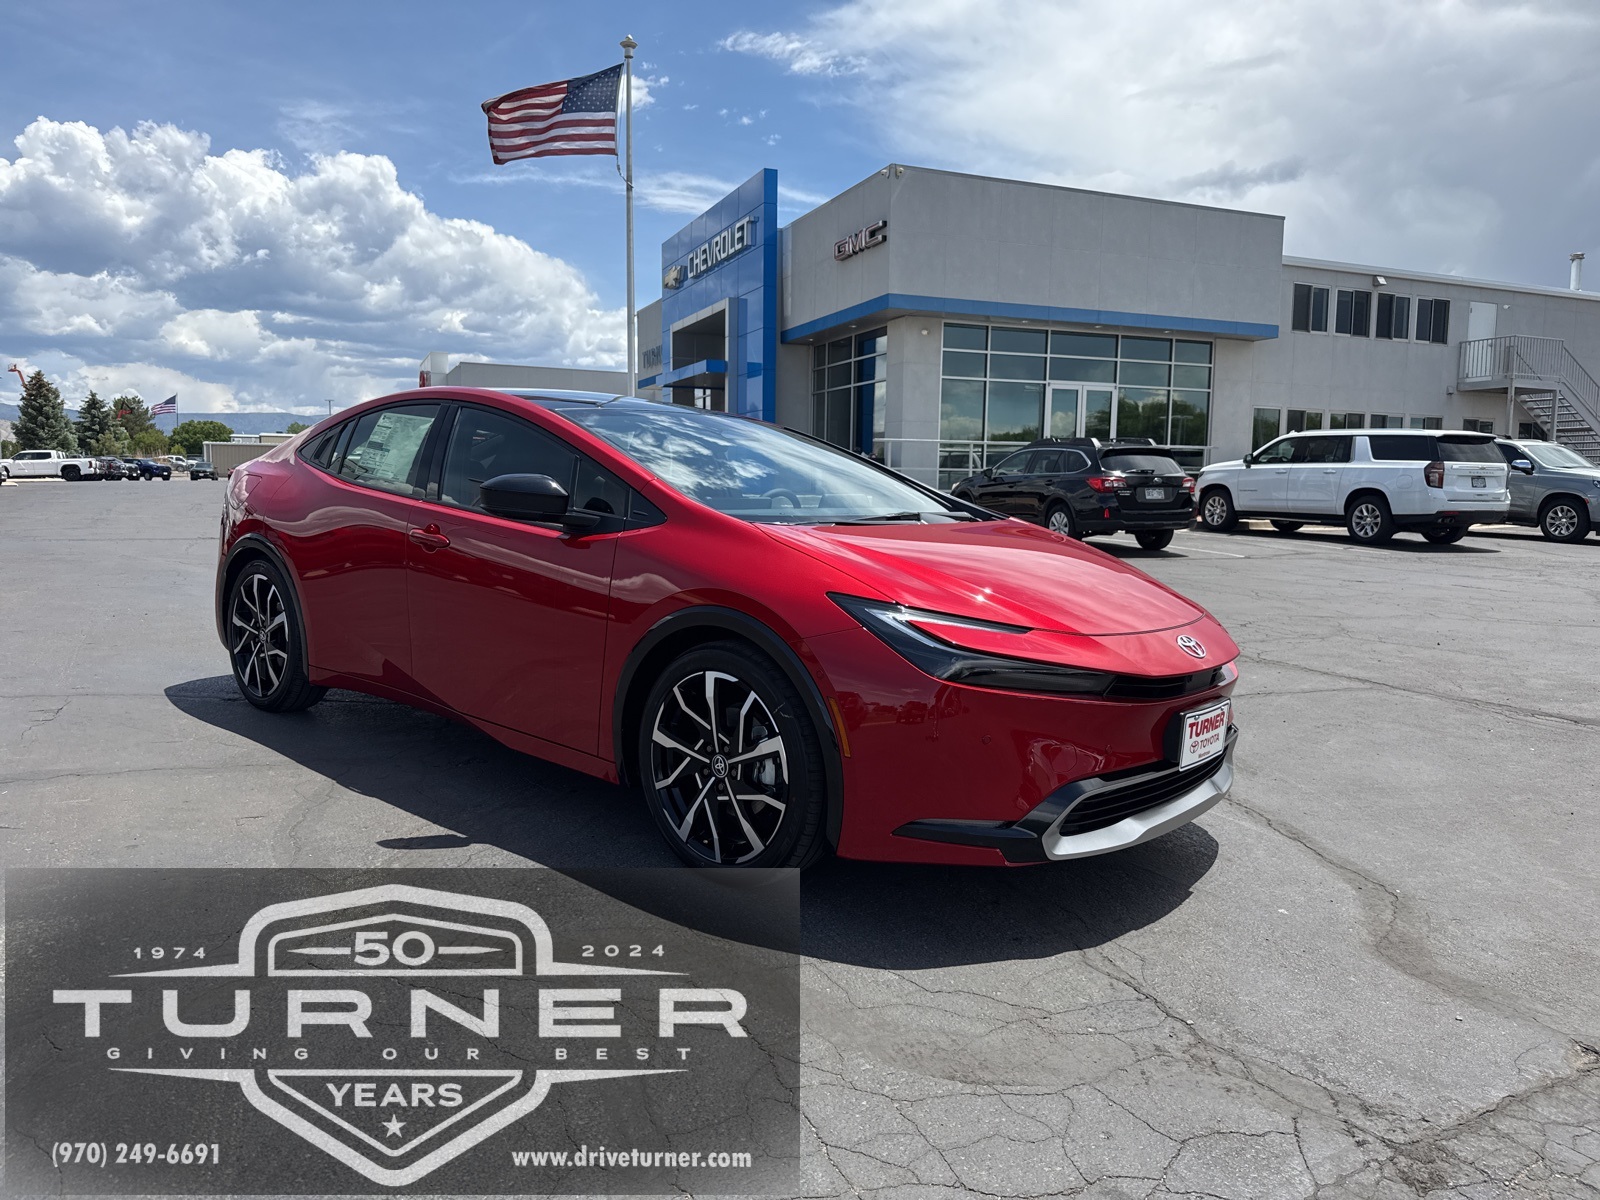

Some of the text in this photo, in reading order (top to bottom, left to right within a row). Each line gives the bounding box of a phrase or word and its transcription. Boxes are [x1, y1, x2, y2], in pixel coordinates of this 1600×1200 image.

[688, 215, 755, 279] CHEVROLET
[834, 220, 887, 261] GMC
[1188, 711, 1225, 739] TURNER
[1200, 733, 1219, 750] TOYOTA
